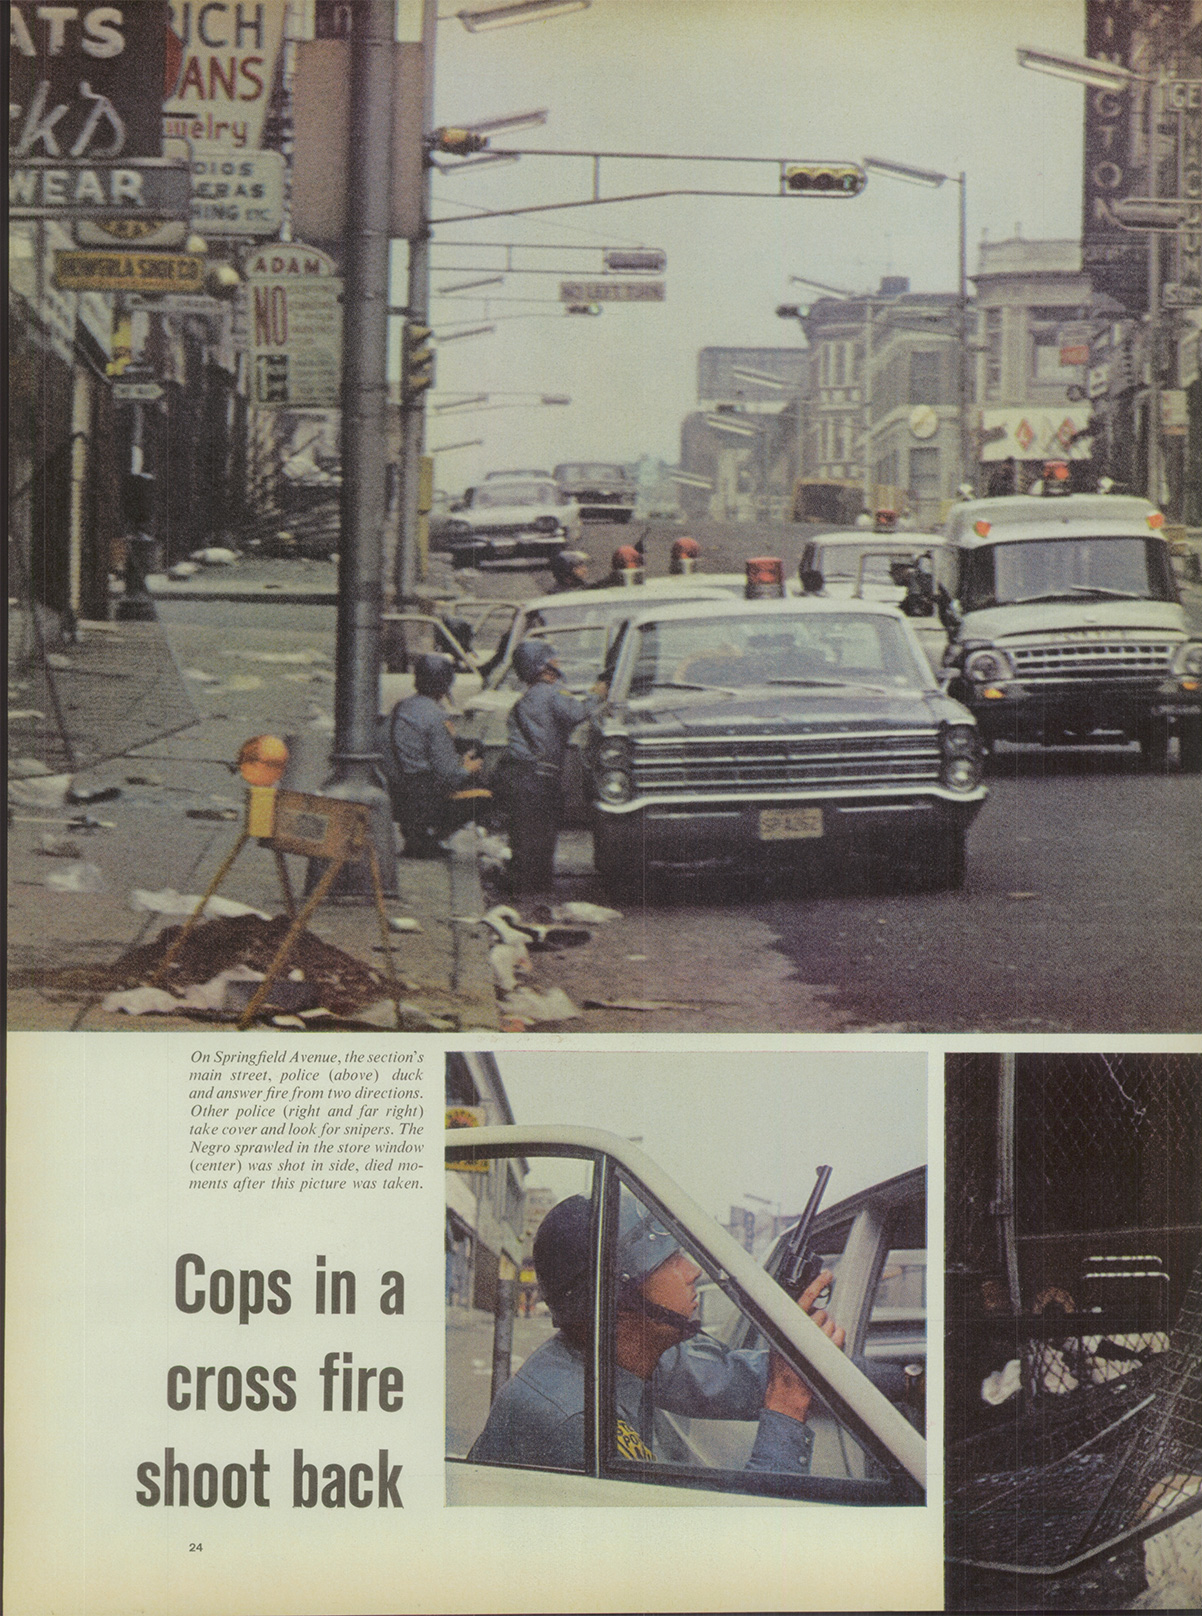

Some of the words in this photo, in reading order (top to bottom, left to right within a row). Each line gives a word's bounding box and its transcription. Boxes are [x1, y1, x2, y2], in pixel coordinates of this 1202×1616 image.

[10, 6, 126, 58] ATS
[177, 55, 264, 101] ANS
[9, 169, 145, 206] WEAR
[254, 256, 320, 275] ADAM
[190, 1050, 211, 1063] On
[213, 1050, 288, 1067] Springfield
[289, 1050, 342, 1064] Avenue,
[344, 1050, 365, 1063] the
[366, 1050, 425, 1063] section's
[189, 1069, 222, 1081] main
[230, 1070, 272, 1082] street,
[279, 1068, 320, 1084] police
[328, 1068, 379, 1083] (above)
[391, 1068, 422, 1081] duck
[188, 1085, 215, 1099] and
[216, 1090, 261, 1099] answer
[265, 1086, 289, 1101] fire
[291, 1085, 324, 1101] from
[327, 1088, 352, 1099] two
[354, 1085, 423, 1099] directions.
[190, 1104, 230, 1118] Other
[235, 1104, 276, 1121] police
[283, 1104, 321, 1120] (right
[327, 1104, 354, 1117] and
[356, 1104, 379, 1121] far
[385, 1104, 424, 1120] right)
[189, 1122, 219, 1136] take
[221, 1126, 258, 1136] cover
[260, 1122, 287, 1136] and
[288, 1122, 316, 1136] look
[320, 1122, 341, 1137] for
[343, 1123, 394, 1139] snipers.
[399, 1122, 424, 1136] The
[191, 1140, 231, 1156] Negro
[233, 1140, 295, 1157] sprawled
[296, 1141, 310, 1154] in
[313, 1140, 334, 1154] the
[338, 1143, 371, 1154] store
[375, 1140, 425, 1153] window
[189, 1159, 242, 1173] (center)
[248, 1162, 273, 1172] was
[279, 1158, 305, 1172] shot
[311, 1159, 324, 1172] in
[330, 1158, 359, 1172] side,
[364, 1158, 394, 1172] died
[397, 1162, 424, 1171] mo-
[188, 1179, 227, 1190] ments
[232, 1176, 266, 1192] after
[271, 1176, 295, 1190] this
[299, 1177, 347, 1193] picture
[353, 1180, 376, 1190] was
[382, 1176, 423, 1190] taken.
[175, 1253, 292, 1325] Cops
[315, 1254, 356, 1315] in
[379, 1270, 405, 1315] a
[167, 1365, 297, 1412] cross
[319, 1351, 405, 1413] fire
[135, 1447, 270, 1508] shoot
[292, 1448, 405, 1509] back
[188, 1542, 203, 1552] 24
